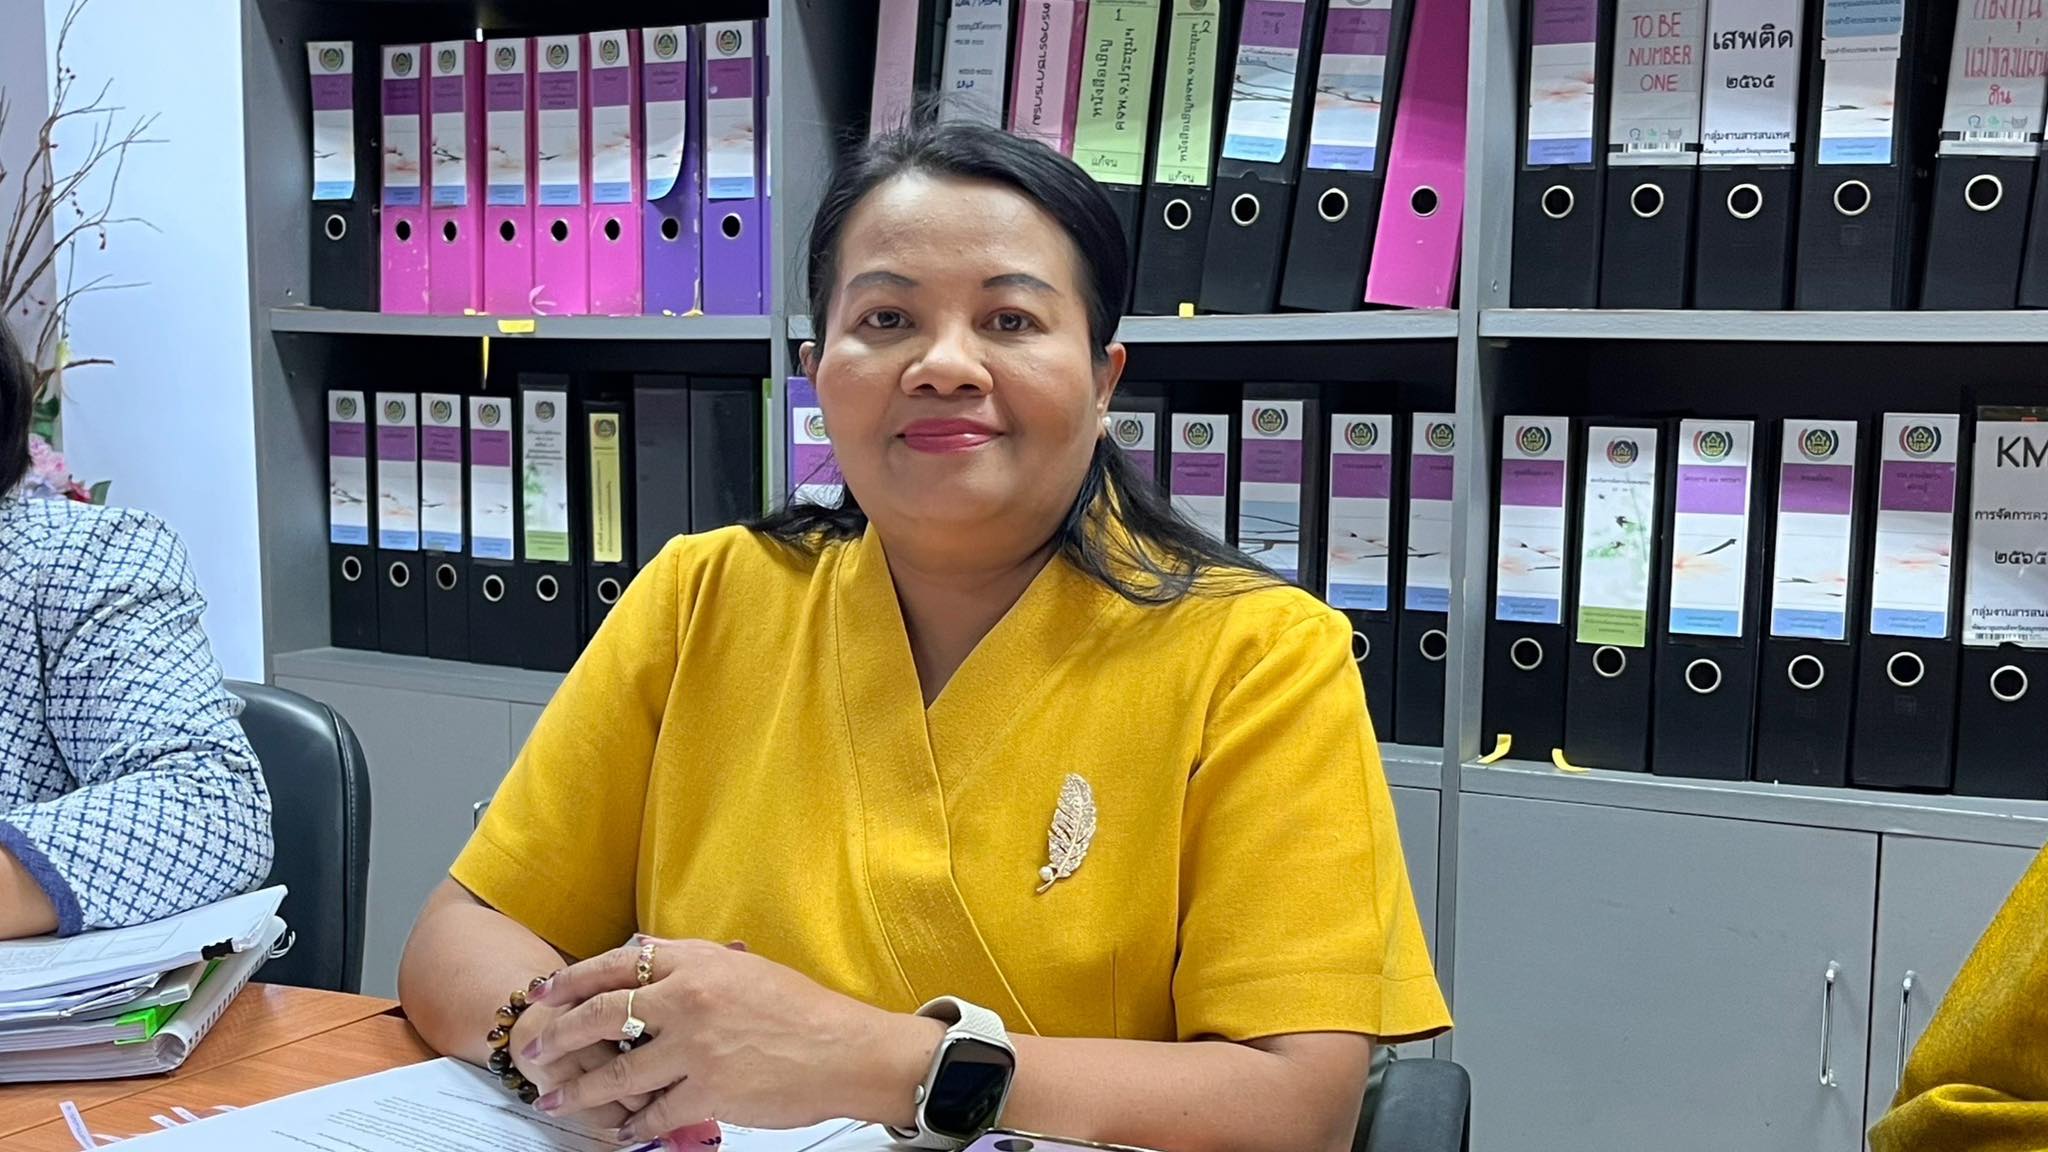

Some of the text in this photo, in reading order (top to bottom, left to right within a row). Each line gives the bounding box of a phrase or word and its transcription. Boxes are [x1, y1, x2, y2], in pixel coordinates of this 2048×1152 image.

[1114, 8, 1125, 22] 1
[1632, 12, 1682, 38] TO BE
[1713, 23, 1794, 50] เสพติด
[1628, 45, 1691, 67] NUMBER
[1640, 74, 1678, 92] ONE
[1726, 74, 1775, 89] ๒๕๖๕
[1704, 130, 1791, 144] กลุ่มงานสารสนเทศ
[1996, 436, 2048, 468] KM
[1994, 550, 2047, 564] ๒๕๖๕
